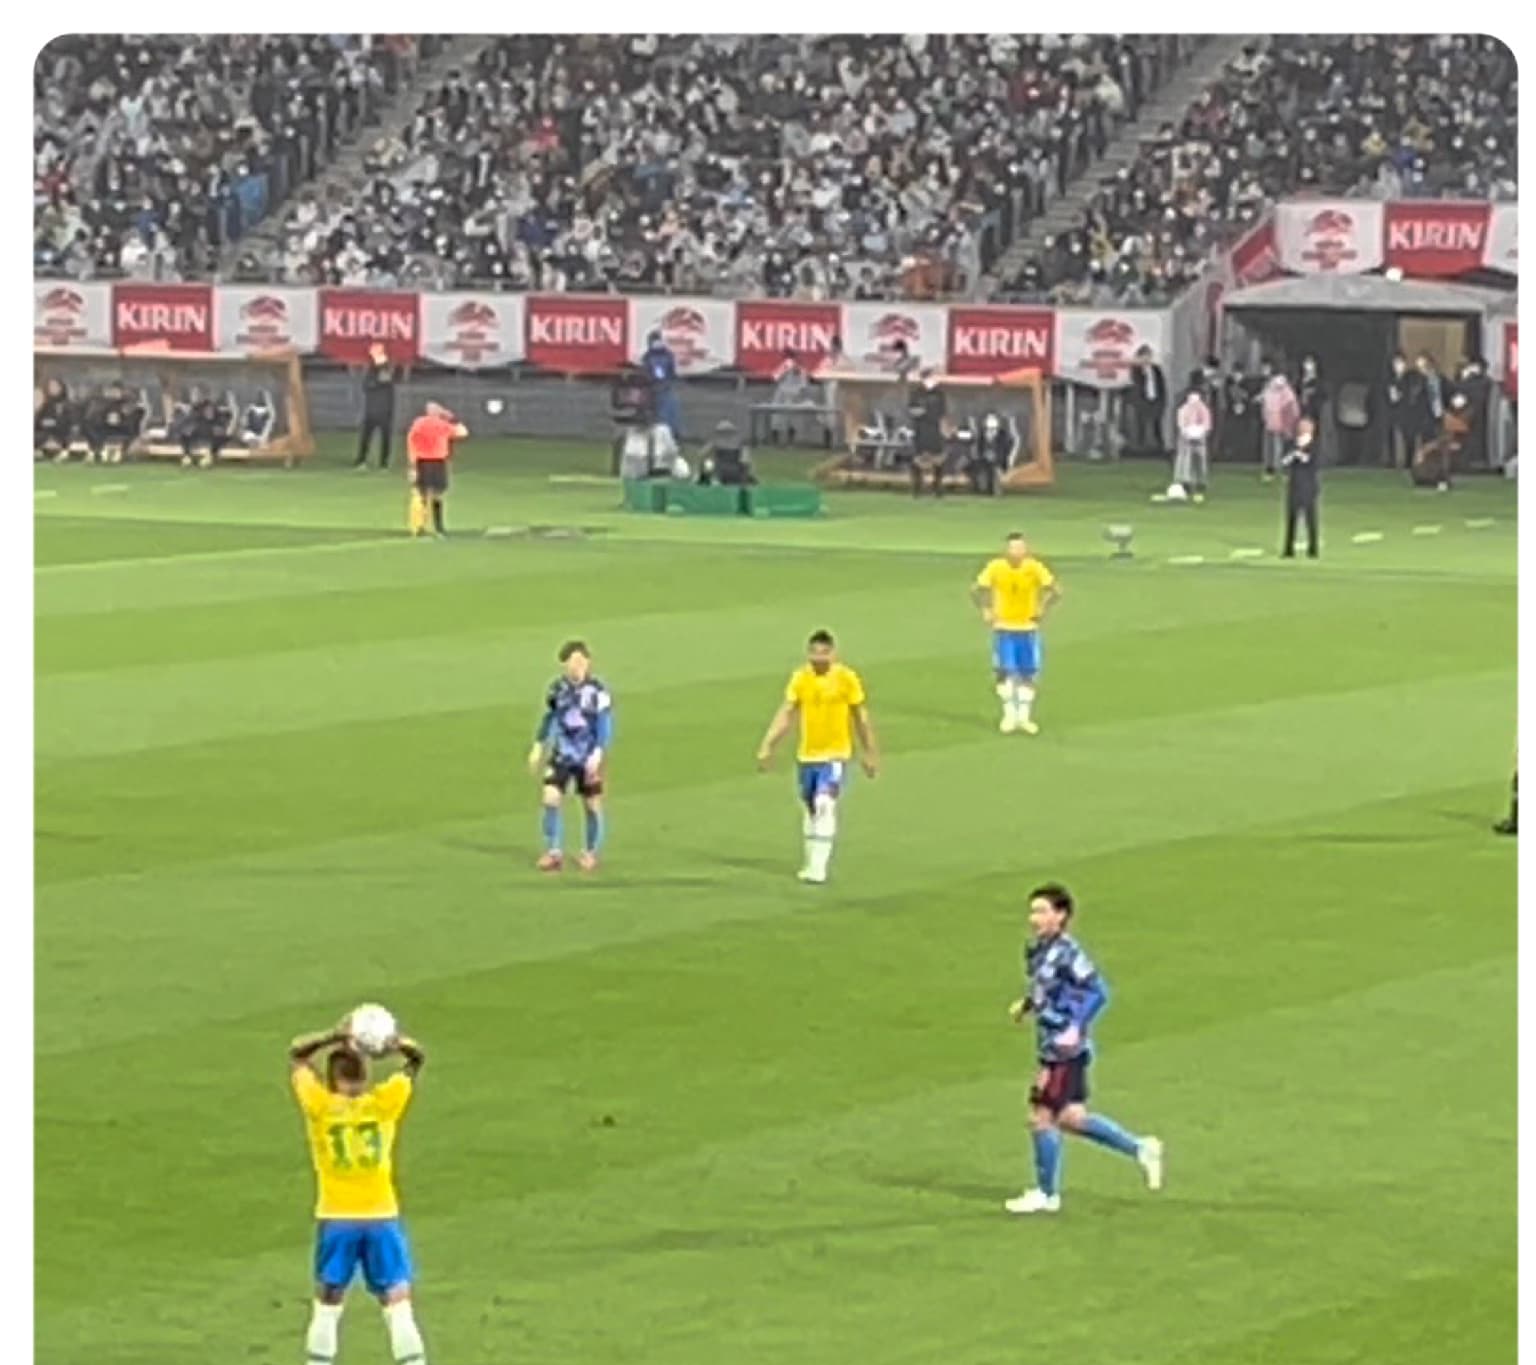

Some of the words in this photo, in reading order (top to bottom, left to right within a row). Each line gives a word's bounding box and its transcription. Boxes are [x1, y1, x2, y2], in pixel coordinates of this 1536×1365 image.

[1390, 220, 1482, 250] KIRIN
[117, 302, 208, 333] KIRIN
[324, 307, 414, 340] KIRIN
[530, 313, 622, 345] KIRIN
[742, 319, 835, 352] KIRIN
[954, 326, 1047, 357] KIRIN
[328, 1121, 382, 1169] 13
